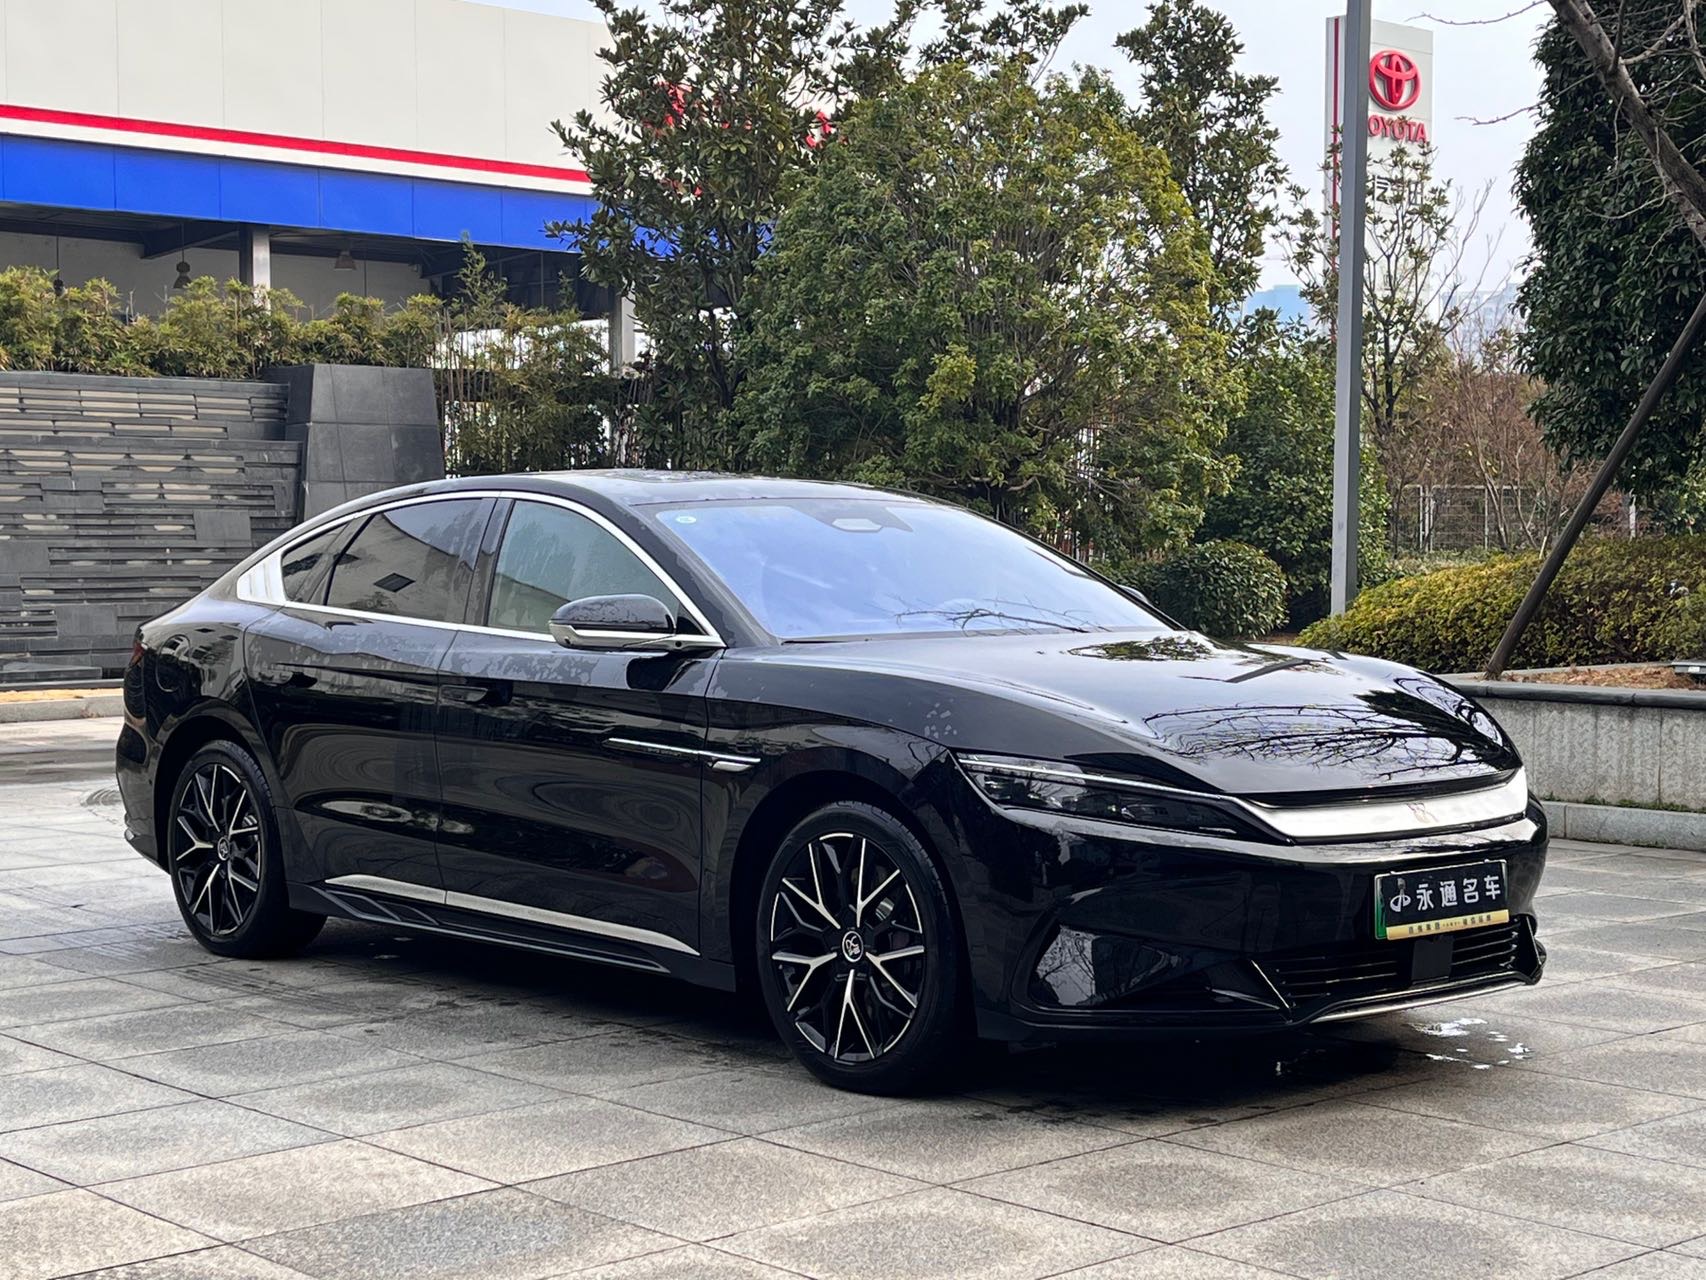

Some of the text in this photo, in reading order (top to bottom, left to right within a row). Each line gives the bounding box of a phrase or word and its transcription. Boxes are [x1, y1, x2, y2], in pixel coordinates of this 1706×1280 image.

[1368, 115, 1427, 142] OYOTA
[1416, 875, 1501, 911] 永通名车
